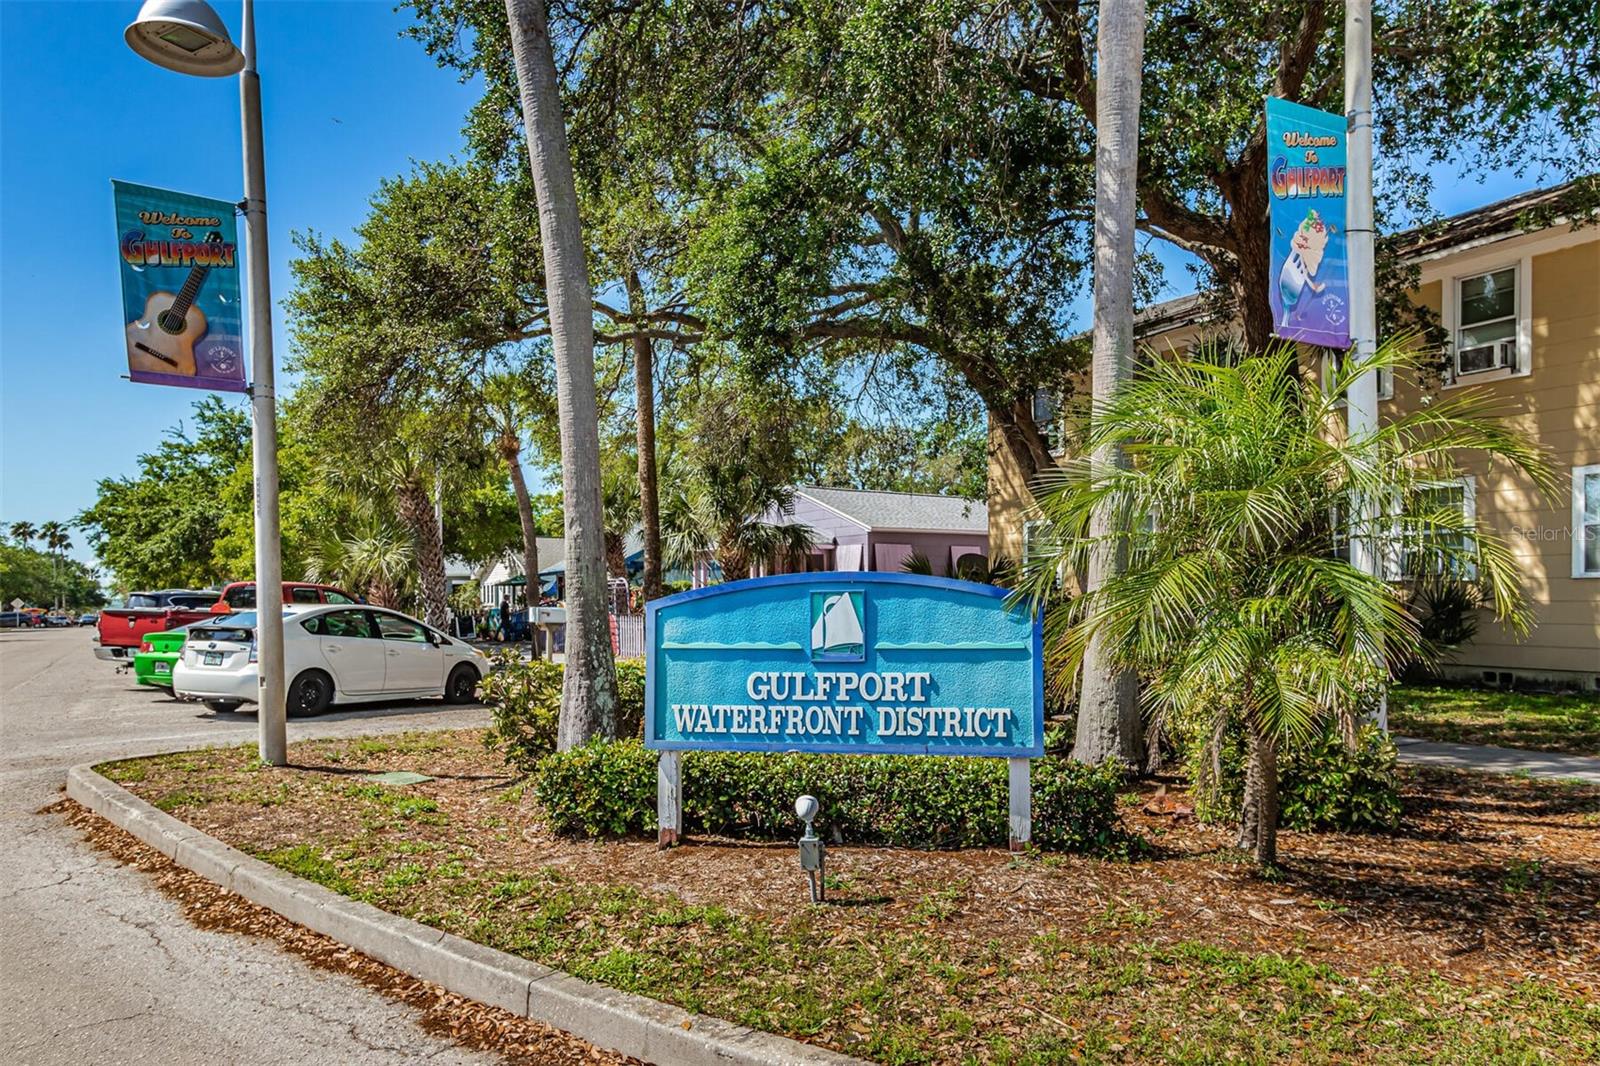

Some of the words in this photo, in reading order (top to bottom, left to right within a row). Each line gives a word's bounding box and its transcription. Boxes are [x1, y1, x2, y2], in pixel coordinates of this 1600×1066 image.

[1283, 131, 1337, 147] Welcome
[1305, 150, 1319, 163] To
[1271, 155, 1346, 199] GULFPORT
[139, 211, 221, 226] Welcome
[172, 227, 193, 239] To
[121, 230, 236, 267] GULFPORT
[746, 672, 930, 702] GULFPORT
[672, 704, 863, 736] WATERFRONT
[877, 707, 1011, 738] DISTRICT
